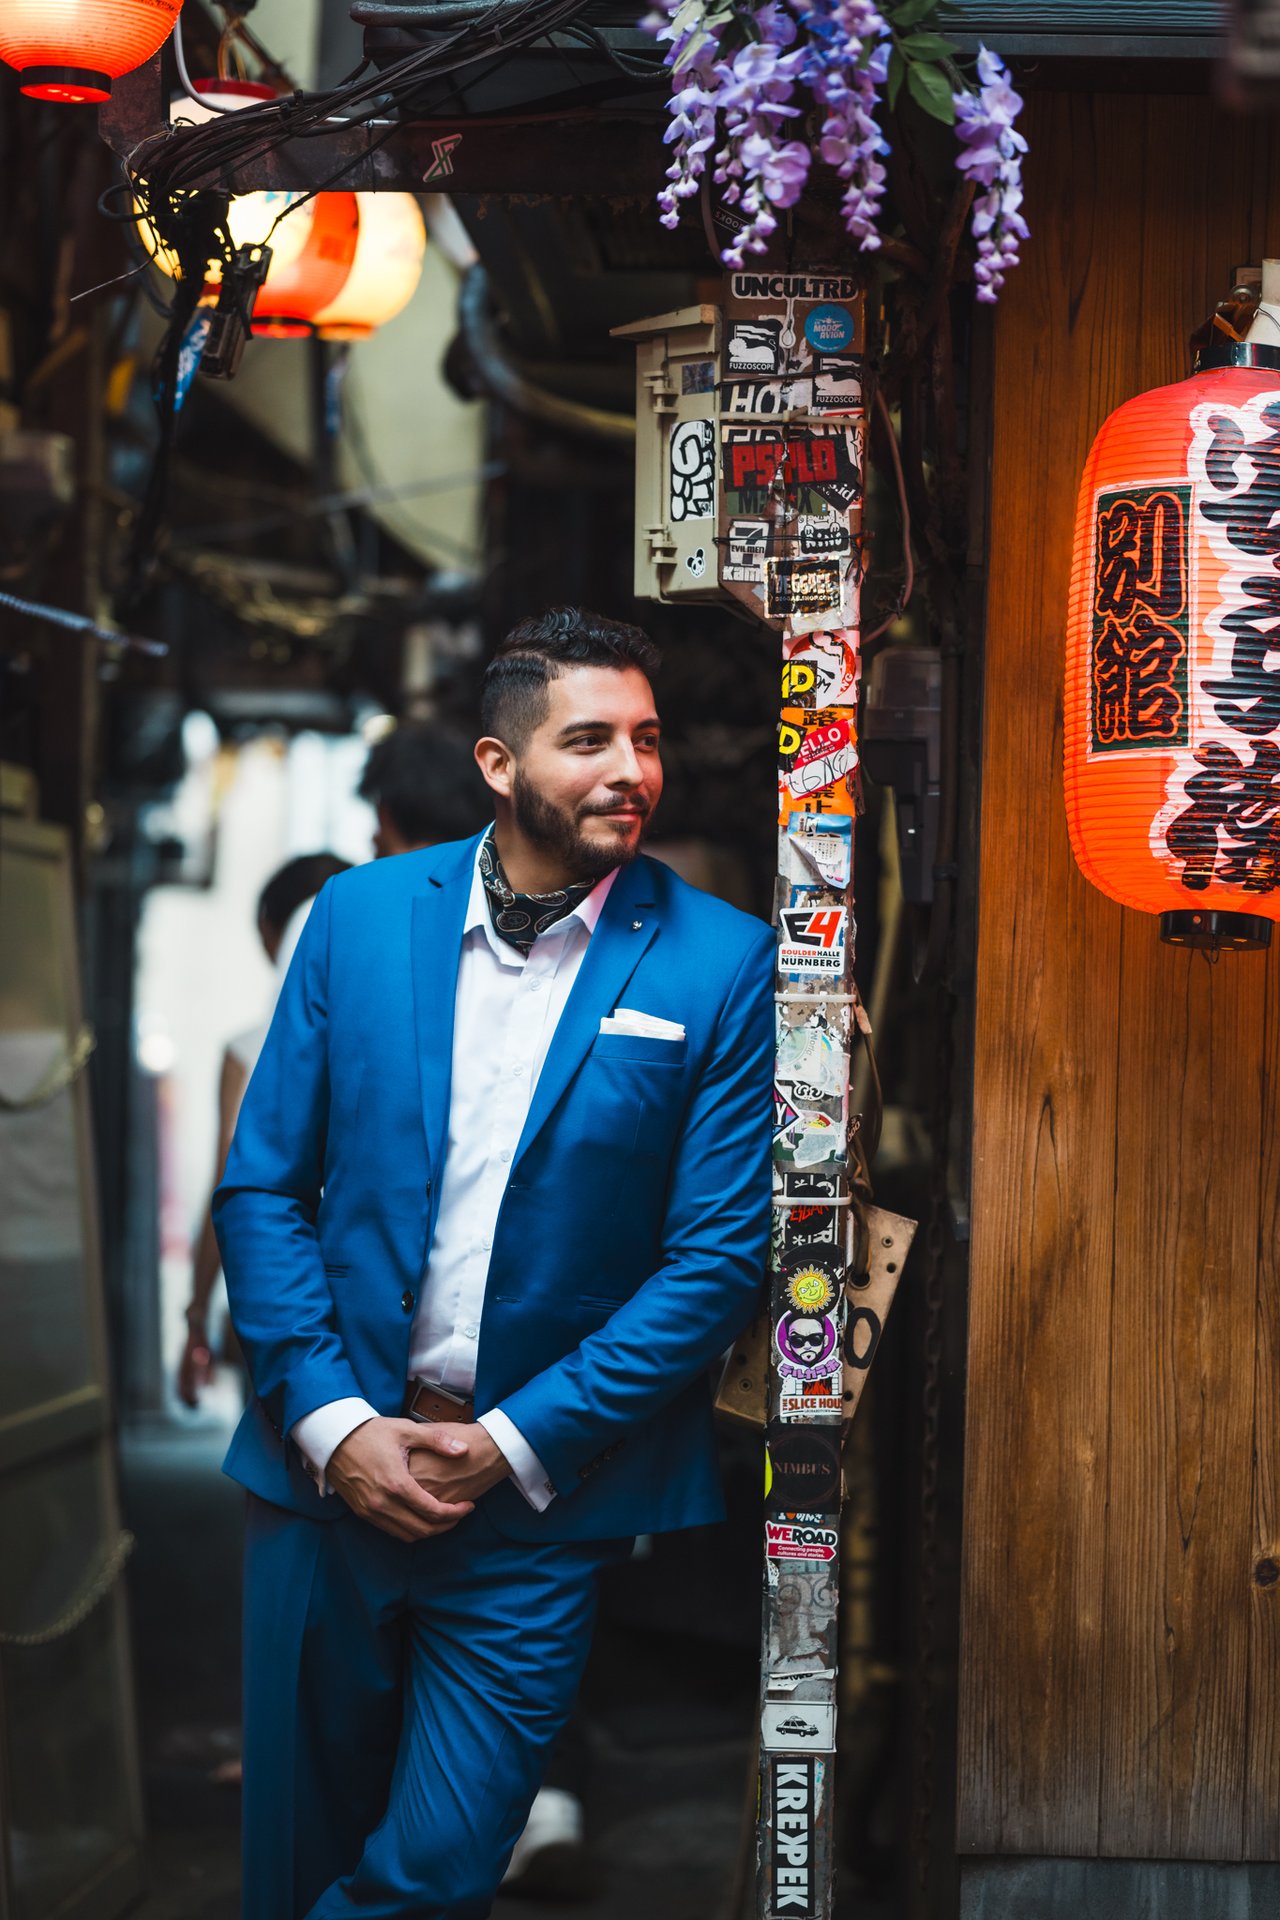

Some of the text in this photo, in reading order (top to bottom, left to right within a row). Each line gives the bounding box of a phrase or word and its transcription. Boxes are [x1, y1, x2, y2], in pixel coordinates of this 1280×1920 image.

[735, 276, 857, 298] UNCULTRD
[729, 362, 775, 371] FUZZOSCOPE
[816, 395, 862, 404] FUZZOSCOPE
[797, 727, 841, 757] ELLO
[784, 911, 842, 948] E4
[788, 1398, 817, 1411] SLICE
[819, 1398, 842, 1410] HOU
[774, 1462, 831, 1474] NIMBUS
